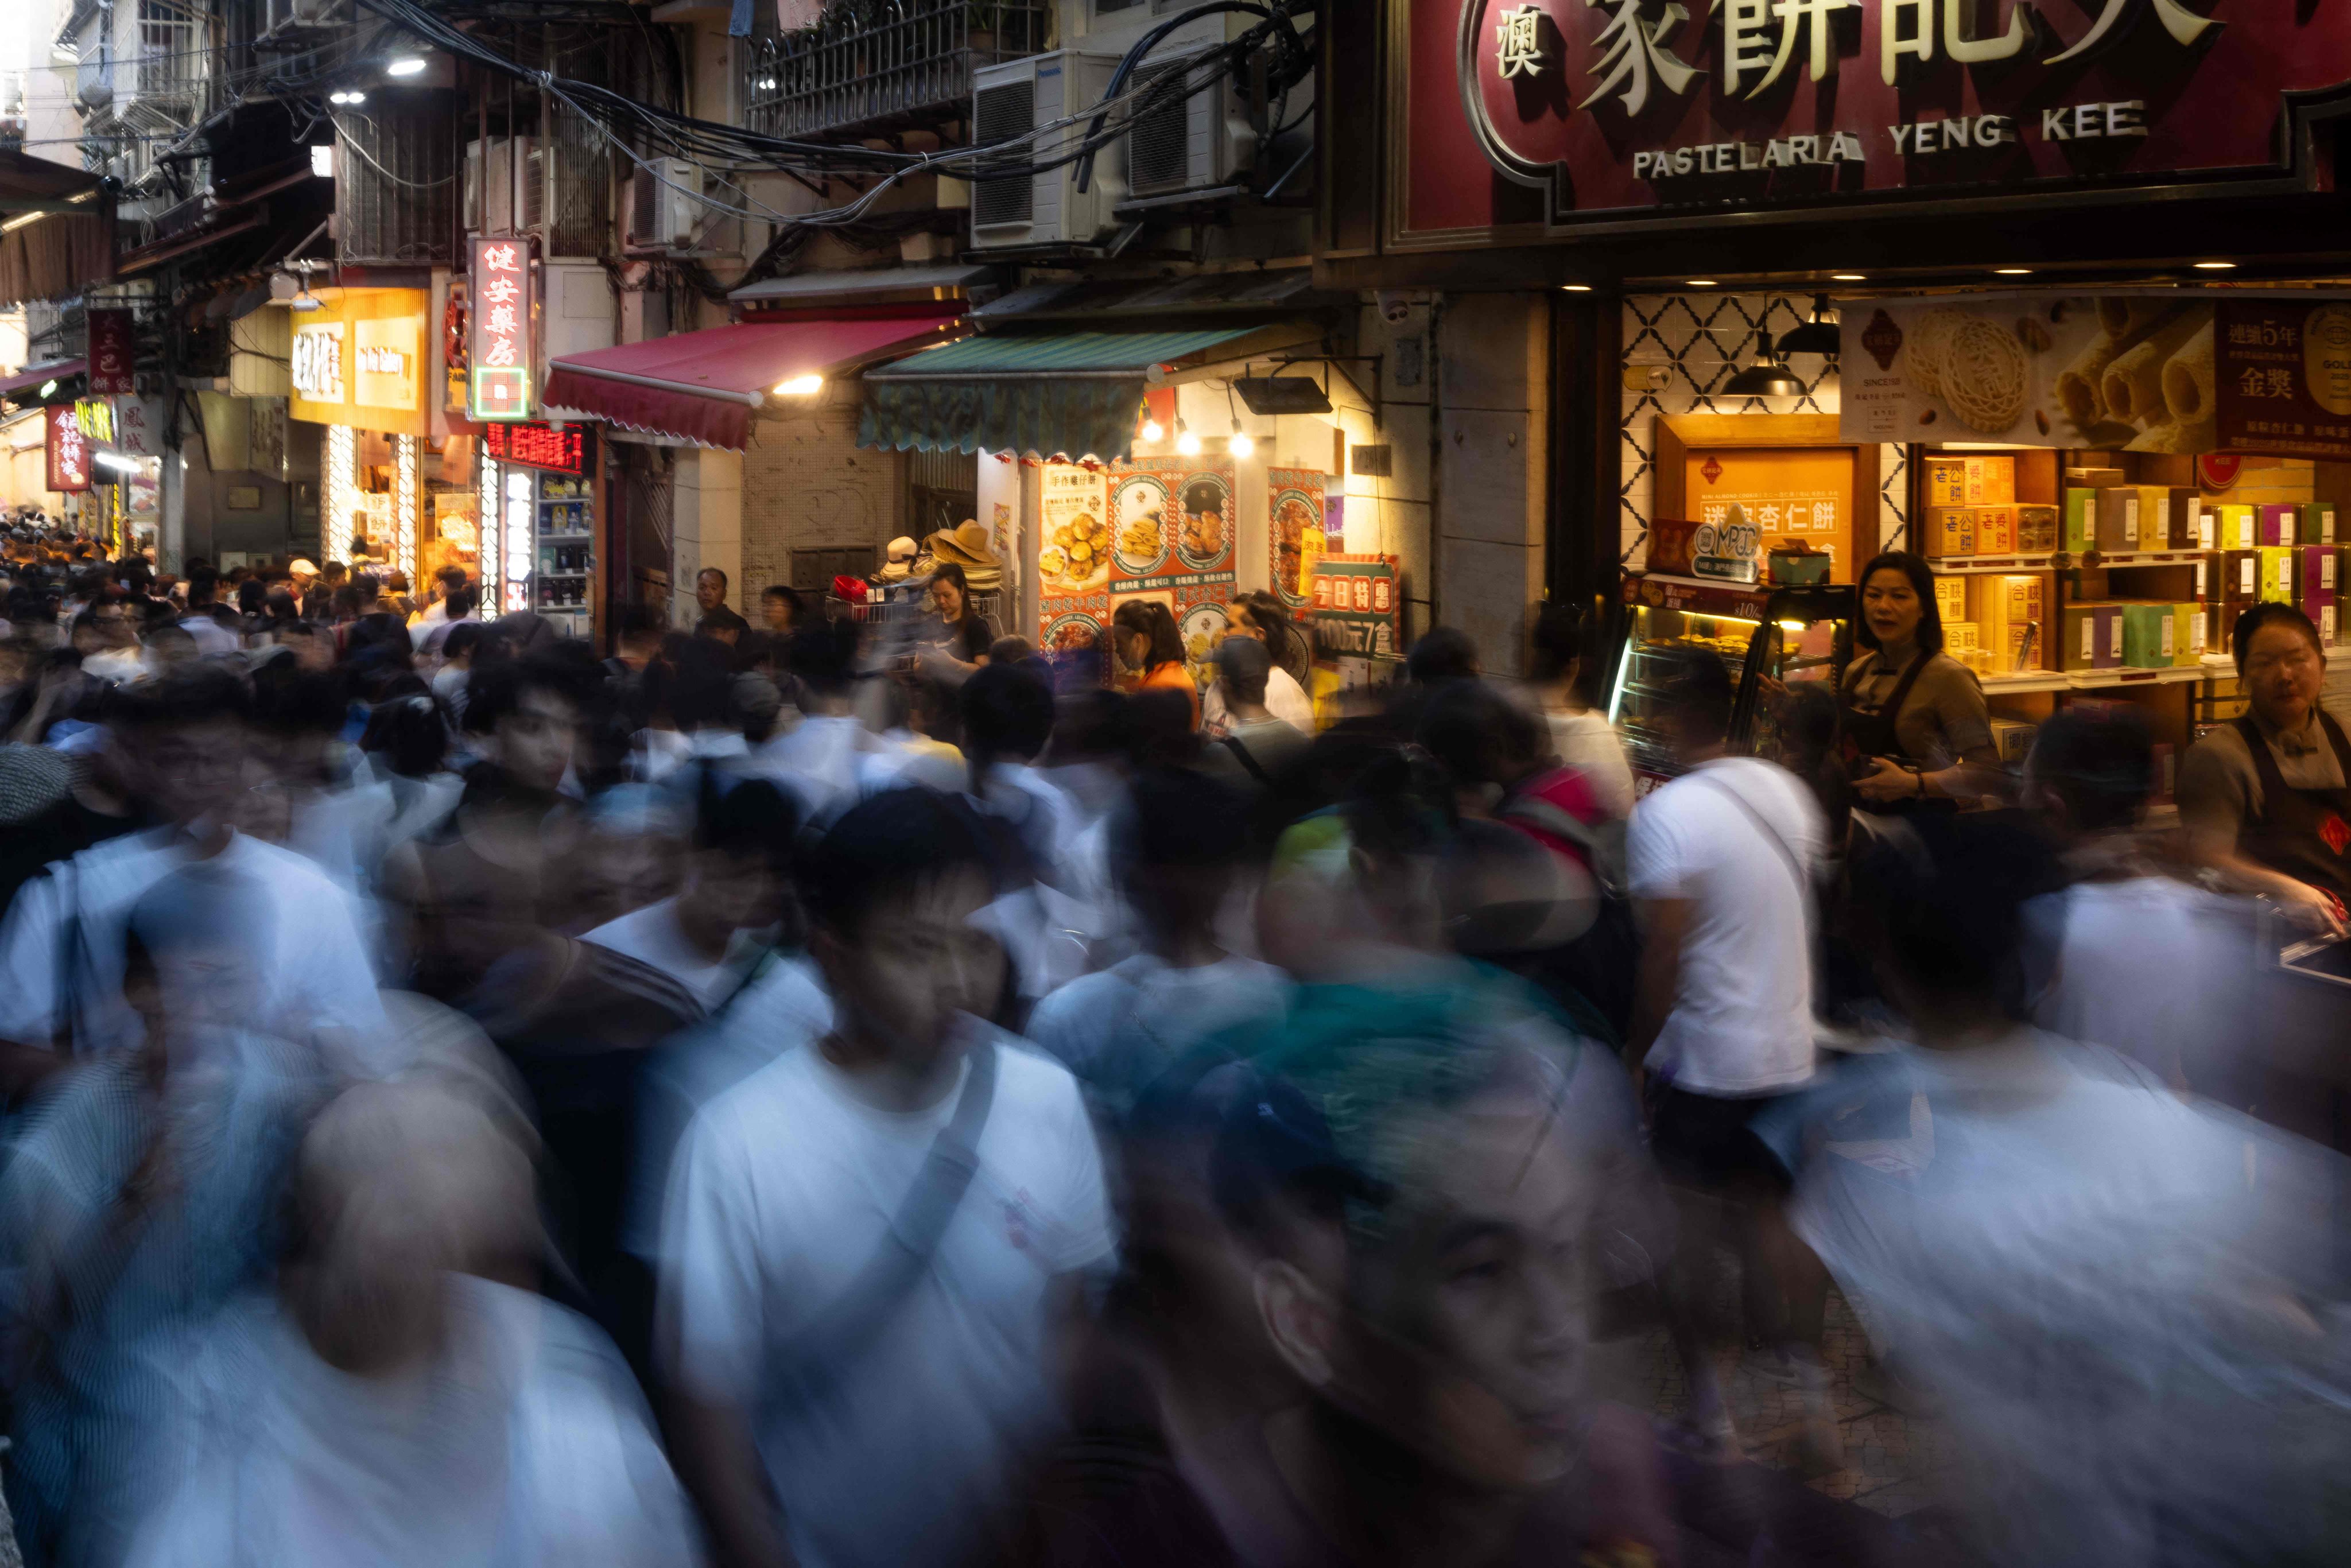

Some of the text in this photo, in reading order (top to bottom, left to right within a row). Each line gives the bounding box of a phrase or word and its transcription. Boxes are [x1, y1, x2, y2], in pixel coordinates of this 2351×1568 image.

[1495, 3, 1544, 79] 澳
[1038, 65, 1061, 77] Panasonic
[1634, 101, 2136, 179] PASTELARIA YENG KEE
[483, 243, 522, 367] 健安藥房
[2238, 366, 2295, 400] 金獎
[2214, 457, 2232, 465] KEE
[1935, 465, 1961, 483] 老公
[1950, 485, 1961, 502] 餅
[1946, 515, 1972, 533] 老公
[1981, 513, 2007, 530] 老婆
[1960, 534, 1971, 551] 餅
[1996, 531, 2007, 548] 餅
[1176, 584, 1236, 603] 葡式杏仁餅
[1313, 579, 1390, 608] 今日特惠
[1039, 594, 1109, 614] 豬肉乾牛肉乾
